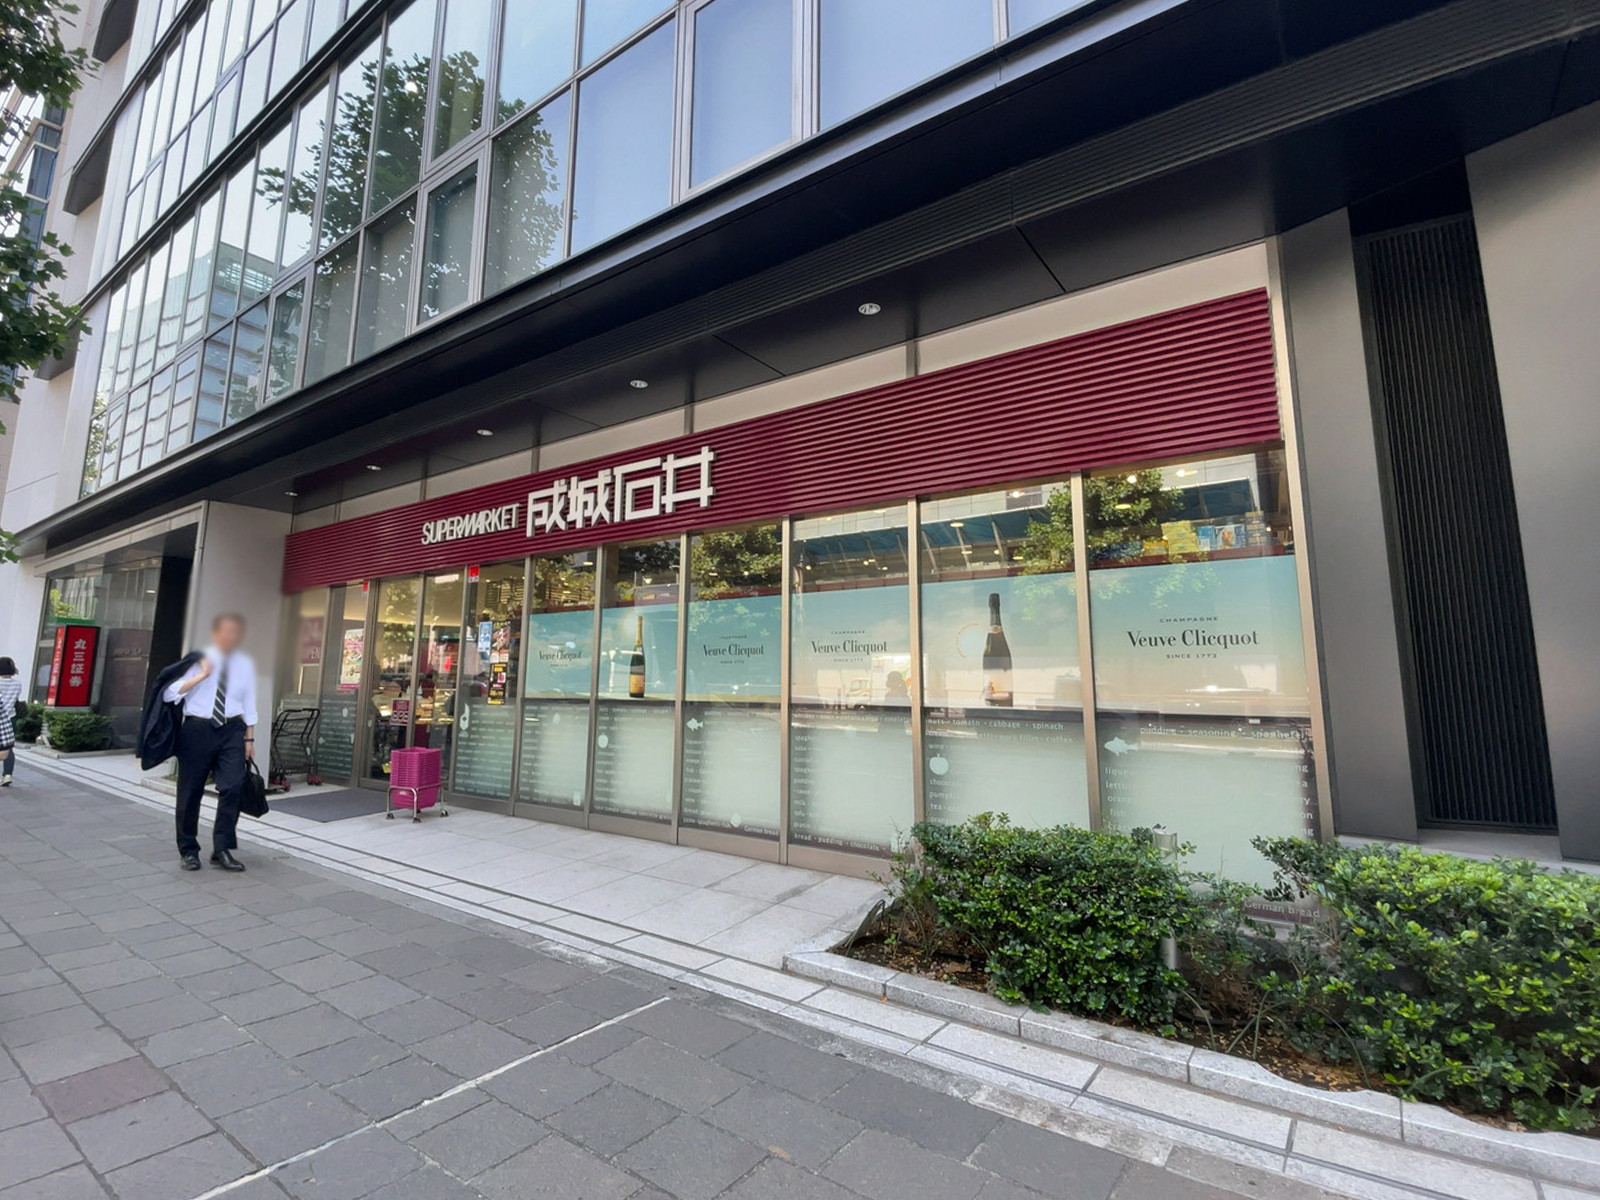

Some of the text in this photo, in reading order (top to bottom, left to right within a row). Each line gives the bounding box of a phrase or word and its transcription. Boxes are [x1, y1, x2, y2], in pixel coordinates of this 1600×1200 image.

[526, 445, 716, 538] 成城石井
[421, 503, 521, 545] SUPERMARKET
[811, 639, 888, 655] Veuve Clicquot
[1127, 628, 1259, 649] Veuve Clicquot
[703, 643, 764, 658] Veuve Clicquot
[952, 719, 981, 728] tomato
[988, 721, 1021, 730] cabbage
[1032, 721, 1065, 731] spinach
